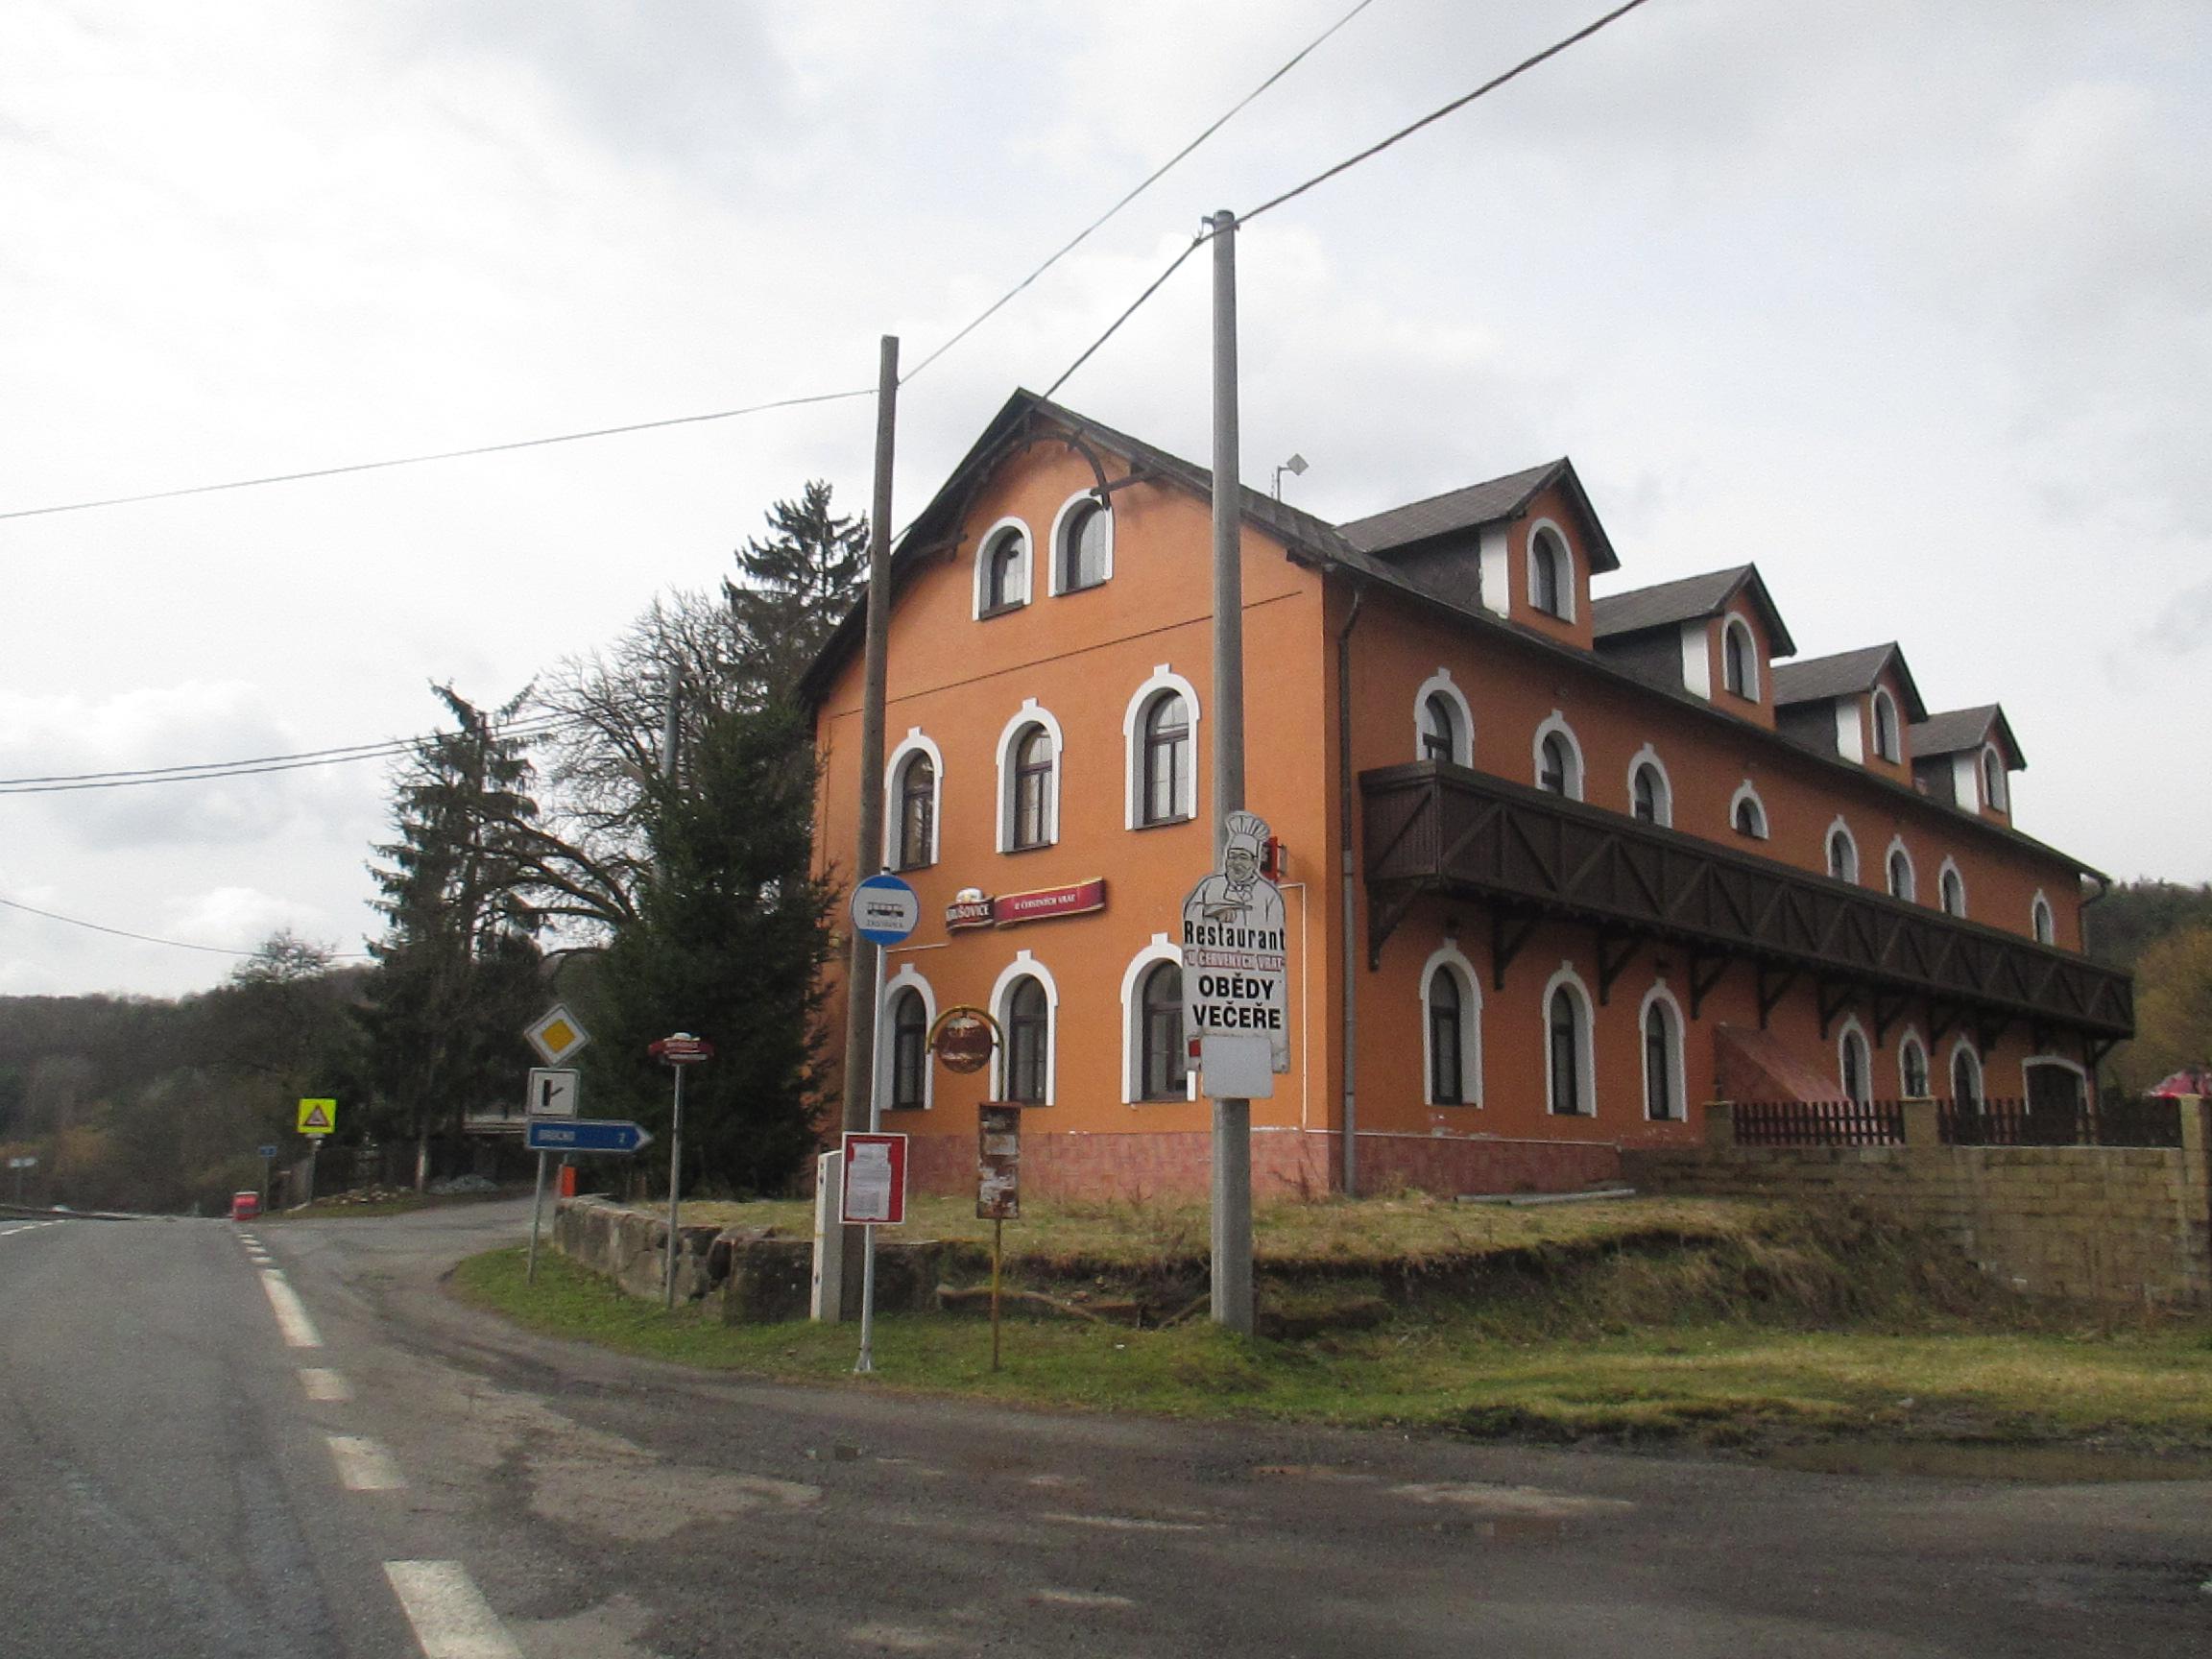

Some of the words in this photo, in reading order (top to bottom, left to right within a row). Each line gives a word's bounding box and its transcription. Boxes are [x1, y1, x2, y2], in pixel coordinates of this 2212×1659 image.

[1184, 920, 1285, 950] Restaurant
[1198, 972, 1274, 999] OBĚDY
[1192, 999, 1281, 1029] VEČEŘE
